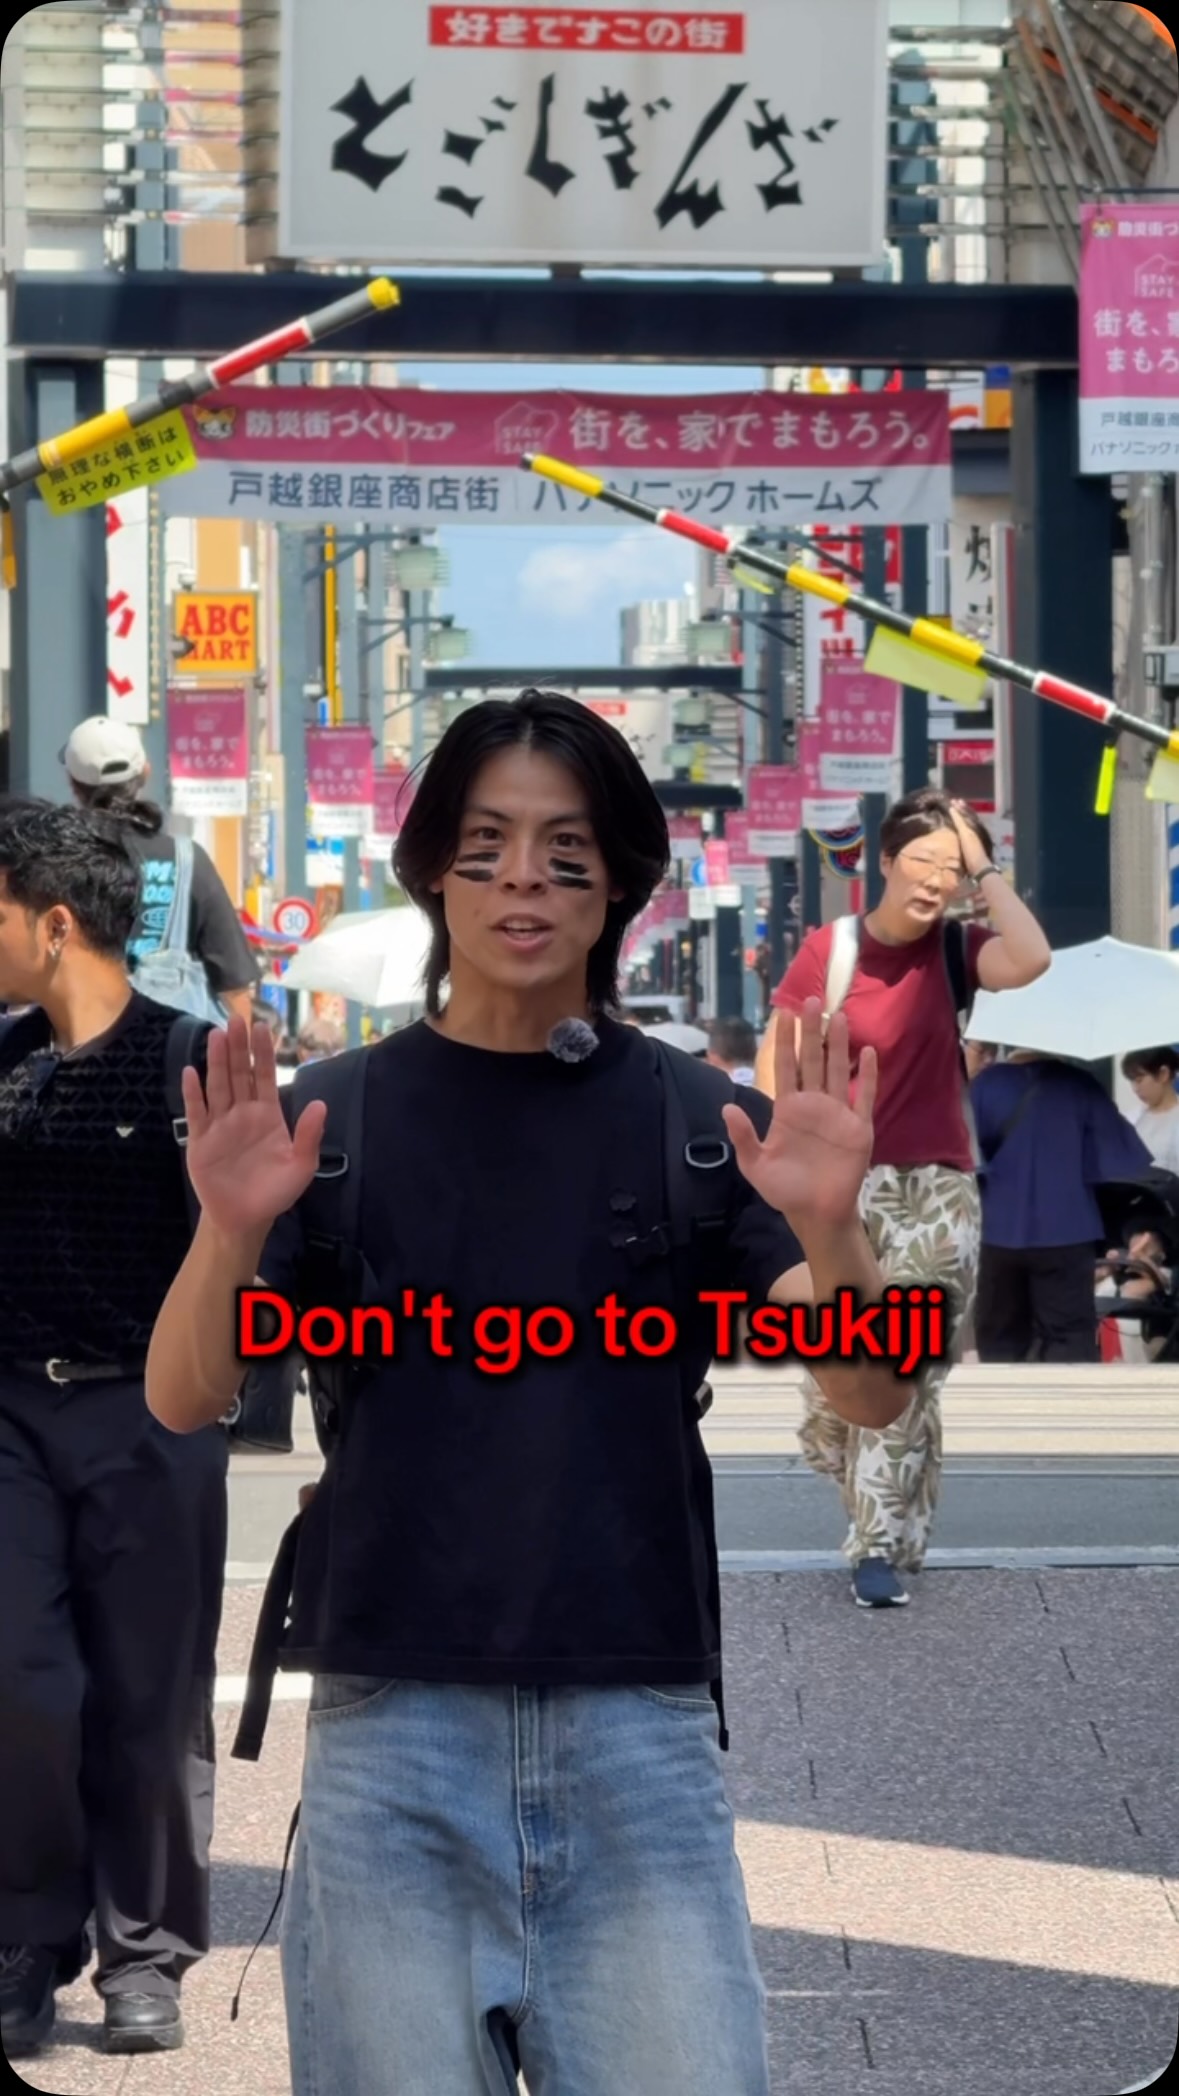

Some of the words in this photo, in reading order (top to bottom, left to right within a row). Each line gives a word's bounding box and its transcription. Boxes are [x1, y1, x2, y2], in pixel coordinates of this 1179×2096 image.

[445, 10, 729, 49] 好きですこの街
[329, 71, 840, 230] とごしぎんざ
[569, 408, 929, 450] 街を、家でまもろう。
[57, 451, 185, 506] おやめ下さい
[229, 469, 499, 511] 戸越銀座商店街
[180, 604, 249, 637] ABC
[283, 913, 306, 931] 30
